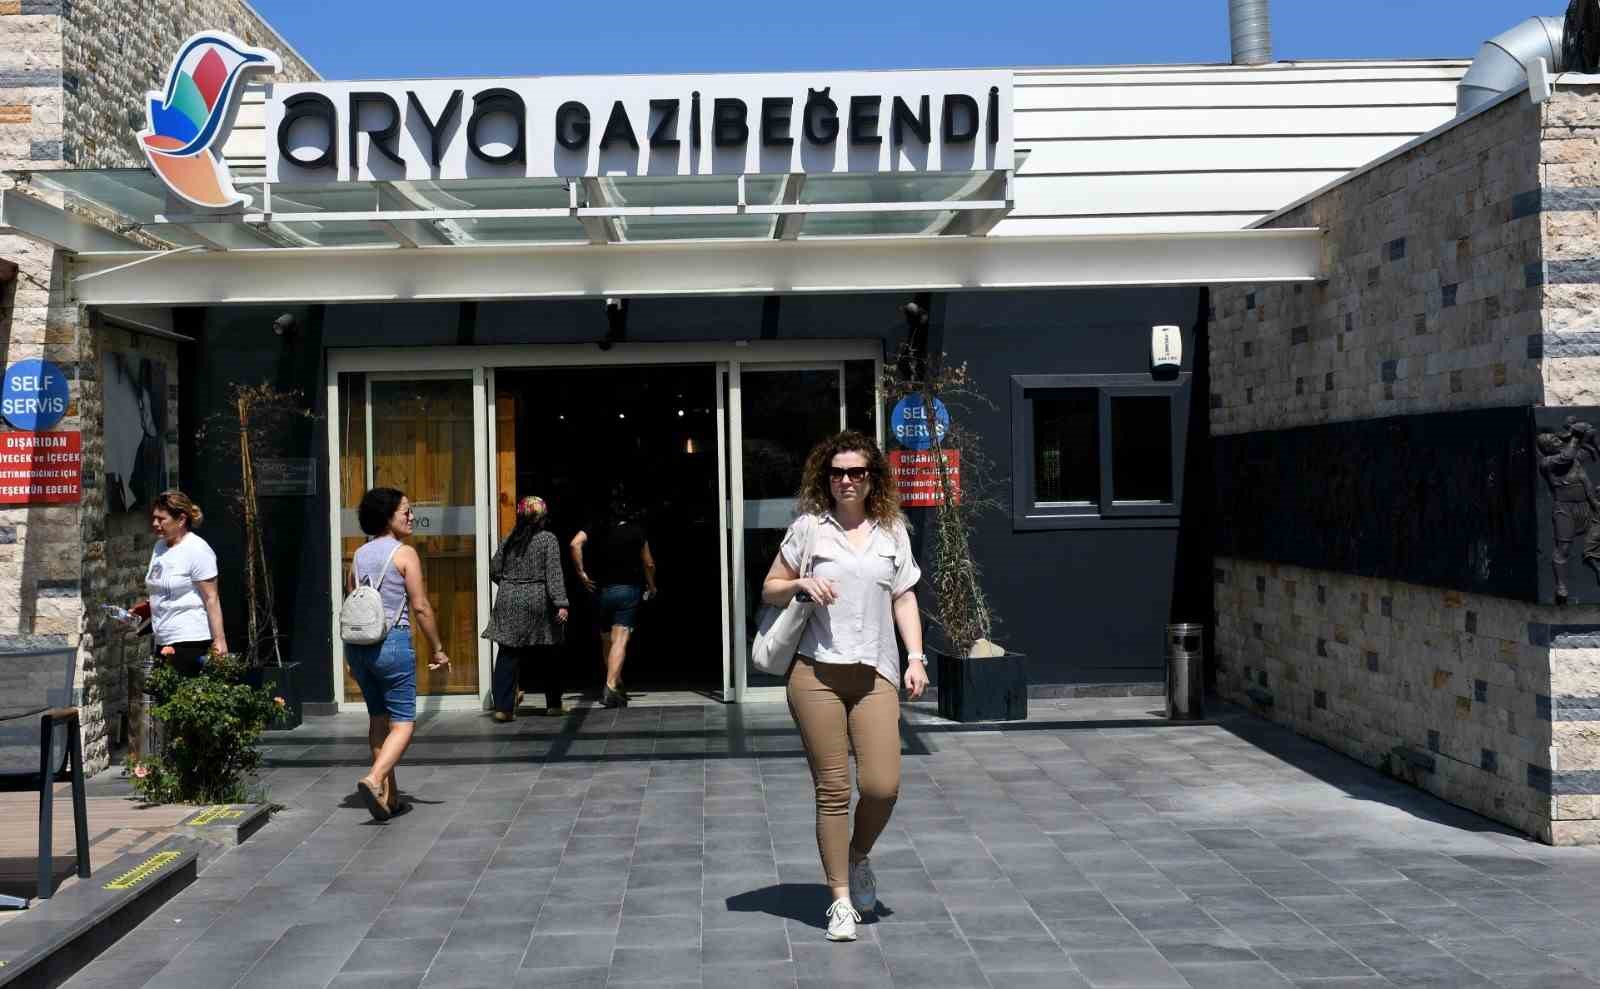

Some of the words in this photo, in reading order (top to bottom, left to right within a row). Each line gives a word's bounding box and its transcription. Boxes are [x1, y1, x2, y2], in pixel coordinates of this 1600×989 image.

[555, 86, 999, 150] GAZİBEĞENDİ
[11, 375, 54, 391] SELF
[7, 437, 67, 450] DIŞARIDAN
[48, 453, 80, 465] İÇECEK
[46, 484, 78, 494] EDERİZ
